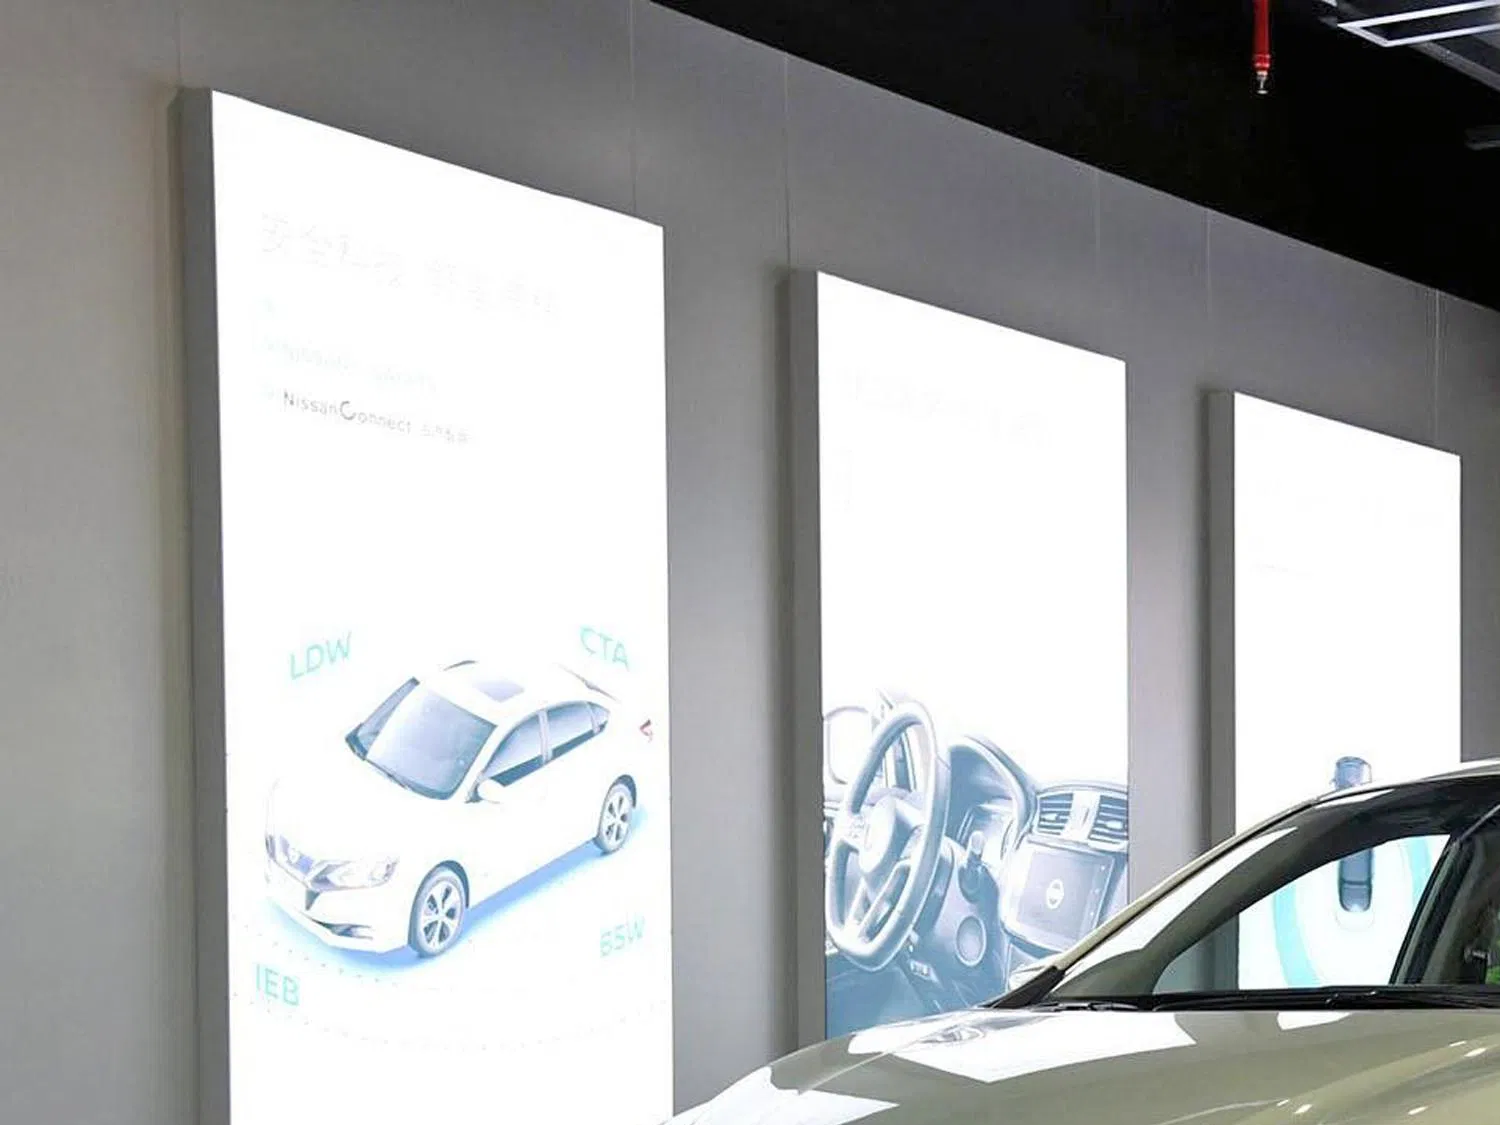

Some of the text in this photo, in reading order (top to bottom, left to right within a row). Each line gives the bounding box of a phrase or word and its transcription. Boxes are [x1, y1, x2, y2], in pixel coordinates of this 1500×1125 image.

[290, 632, 353, 680] LDW
[579, 627, 631, 668] CTA
[254, 963, 300, 1007] IEB
